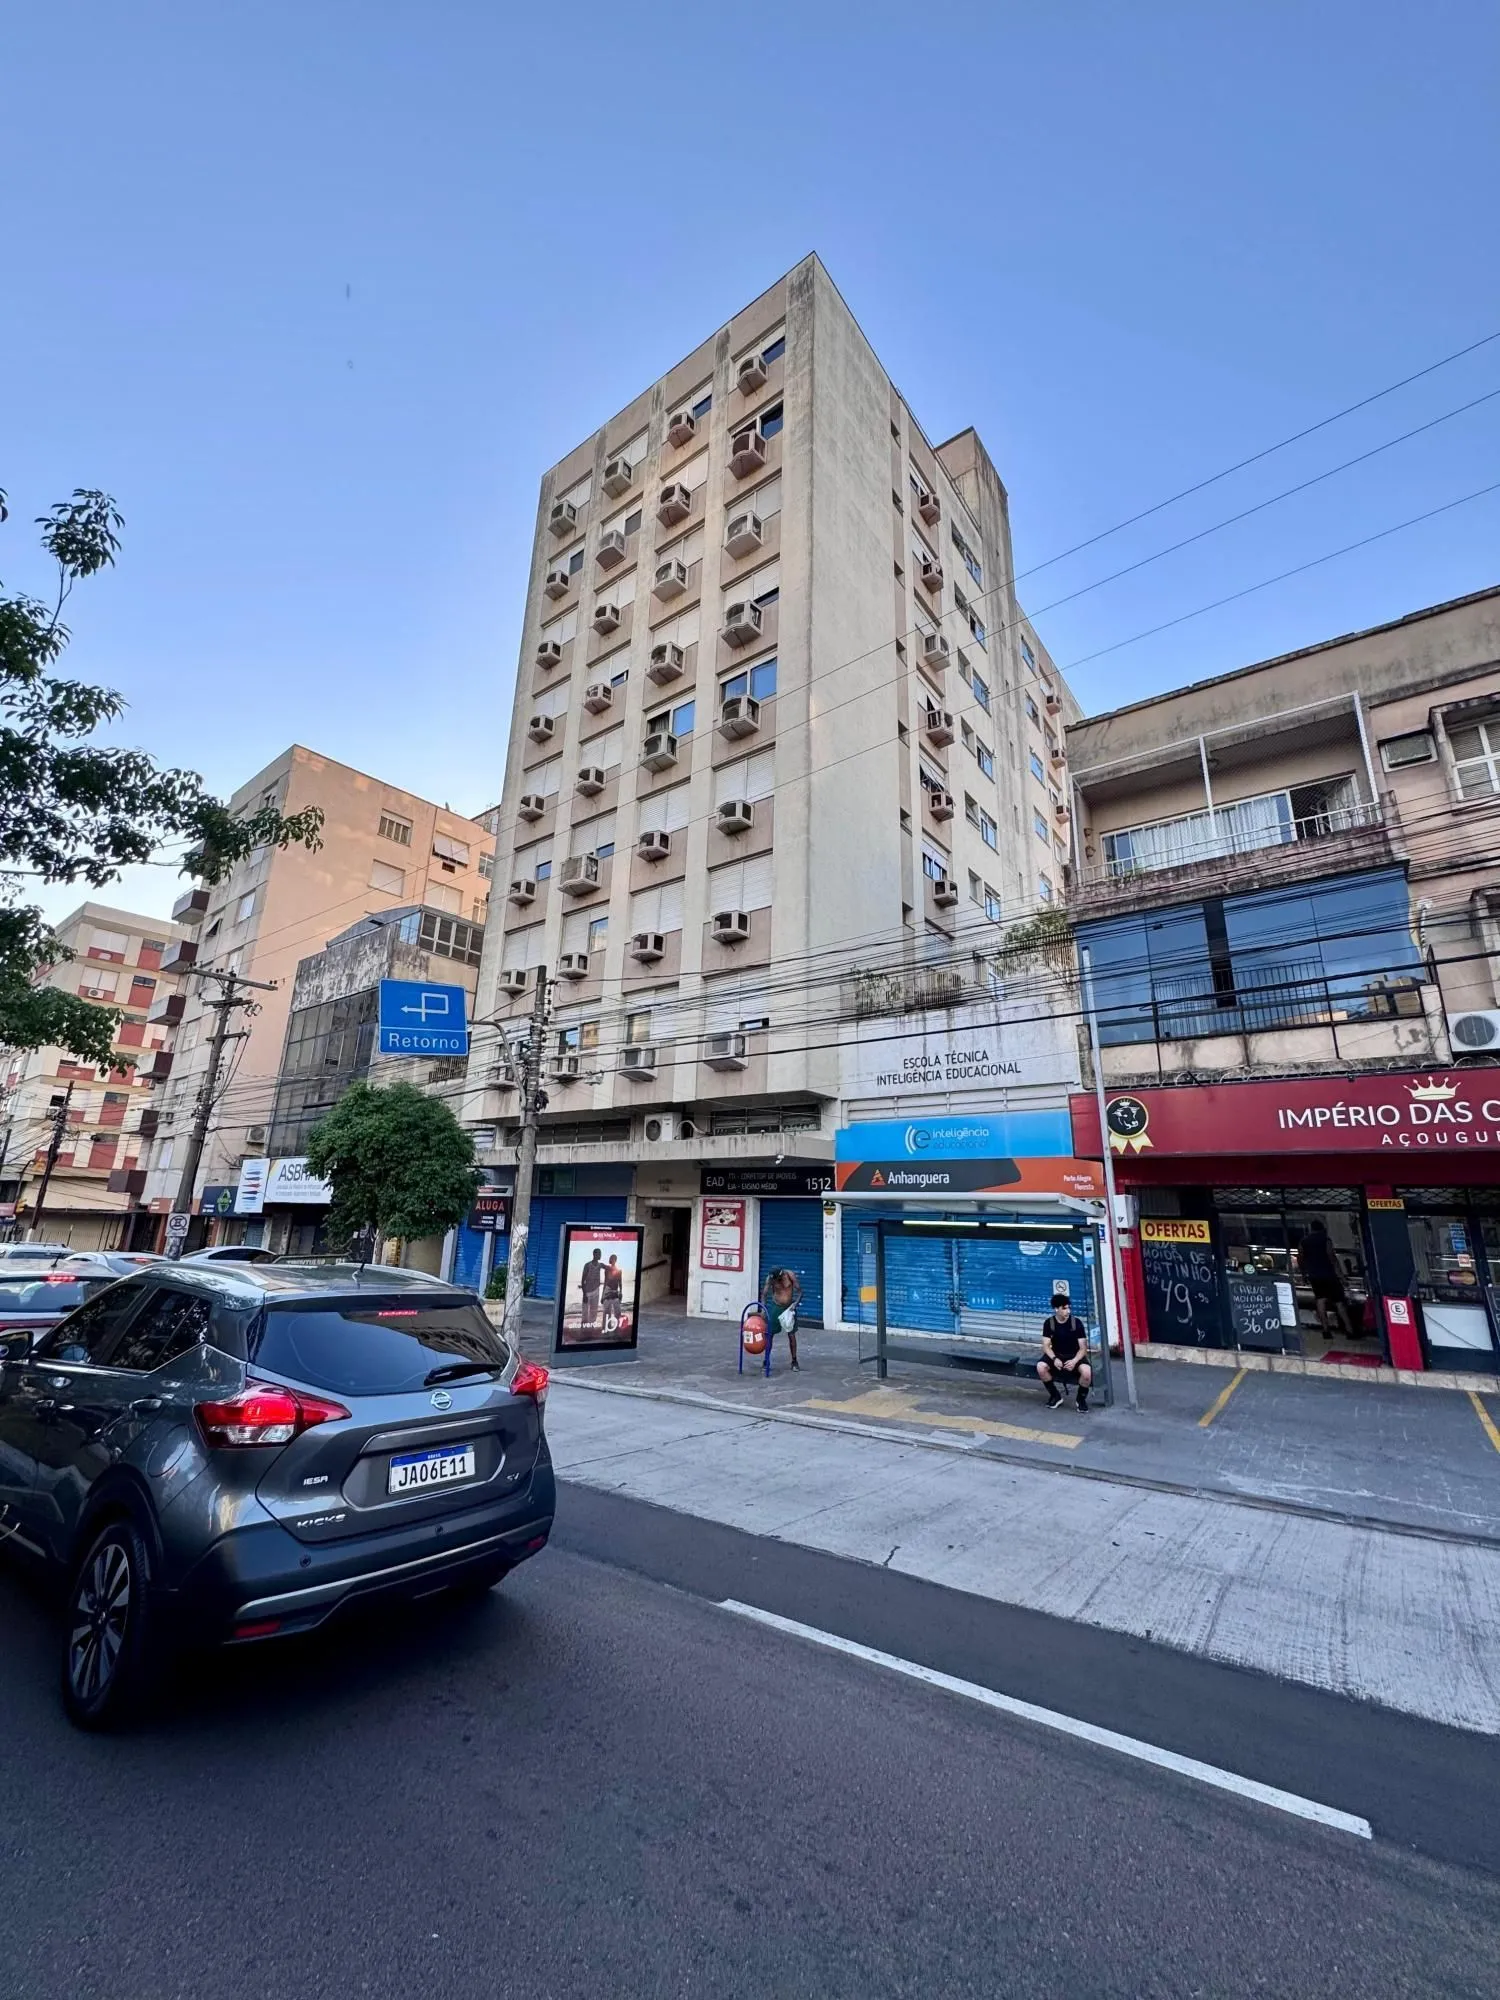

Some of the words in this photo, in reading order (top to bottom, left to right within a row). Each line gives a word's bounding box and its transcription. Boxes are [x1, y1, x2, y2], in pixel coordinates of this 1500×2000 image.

[388, 1032, 459, 1049] Retorno
[903, 1055, 942, 1070] ESCOLA
[944, 1050, 989, 1065] TÉCNICA
[876, 1069, 943, 1086] INTELIGÊNCIA
[945, 1061, 1022, 1080] EDUCACIONAL
[1278, 1101, 1401, 1129] IMPÉRIO
[1409, 1101, 1474, 1125] DAS
[932, 1126, 990, 1140] inteligência
[706, 1176, 725, 1188] EAD
[805, 1177, 831, 1190] 1512
[887, 1171, 950, 1188] Anhanguera
[475, 1200, 505, 1211] ALUGA
[1369, 1200, 1401, 1208] OFERTAS
[1144, 1222, 1206, 1239] OFERTAS
[1144, 1258, 1212, 1283] PATINHO
[1239, 1317, 1280, 1334] 36,00
[303, 1475, 329, 1486] IESA
[297, 1513, 346, 1528] KICKS
